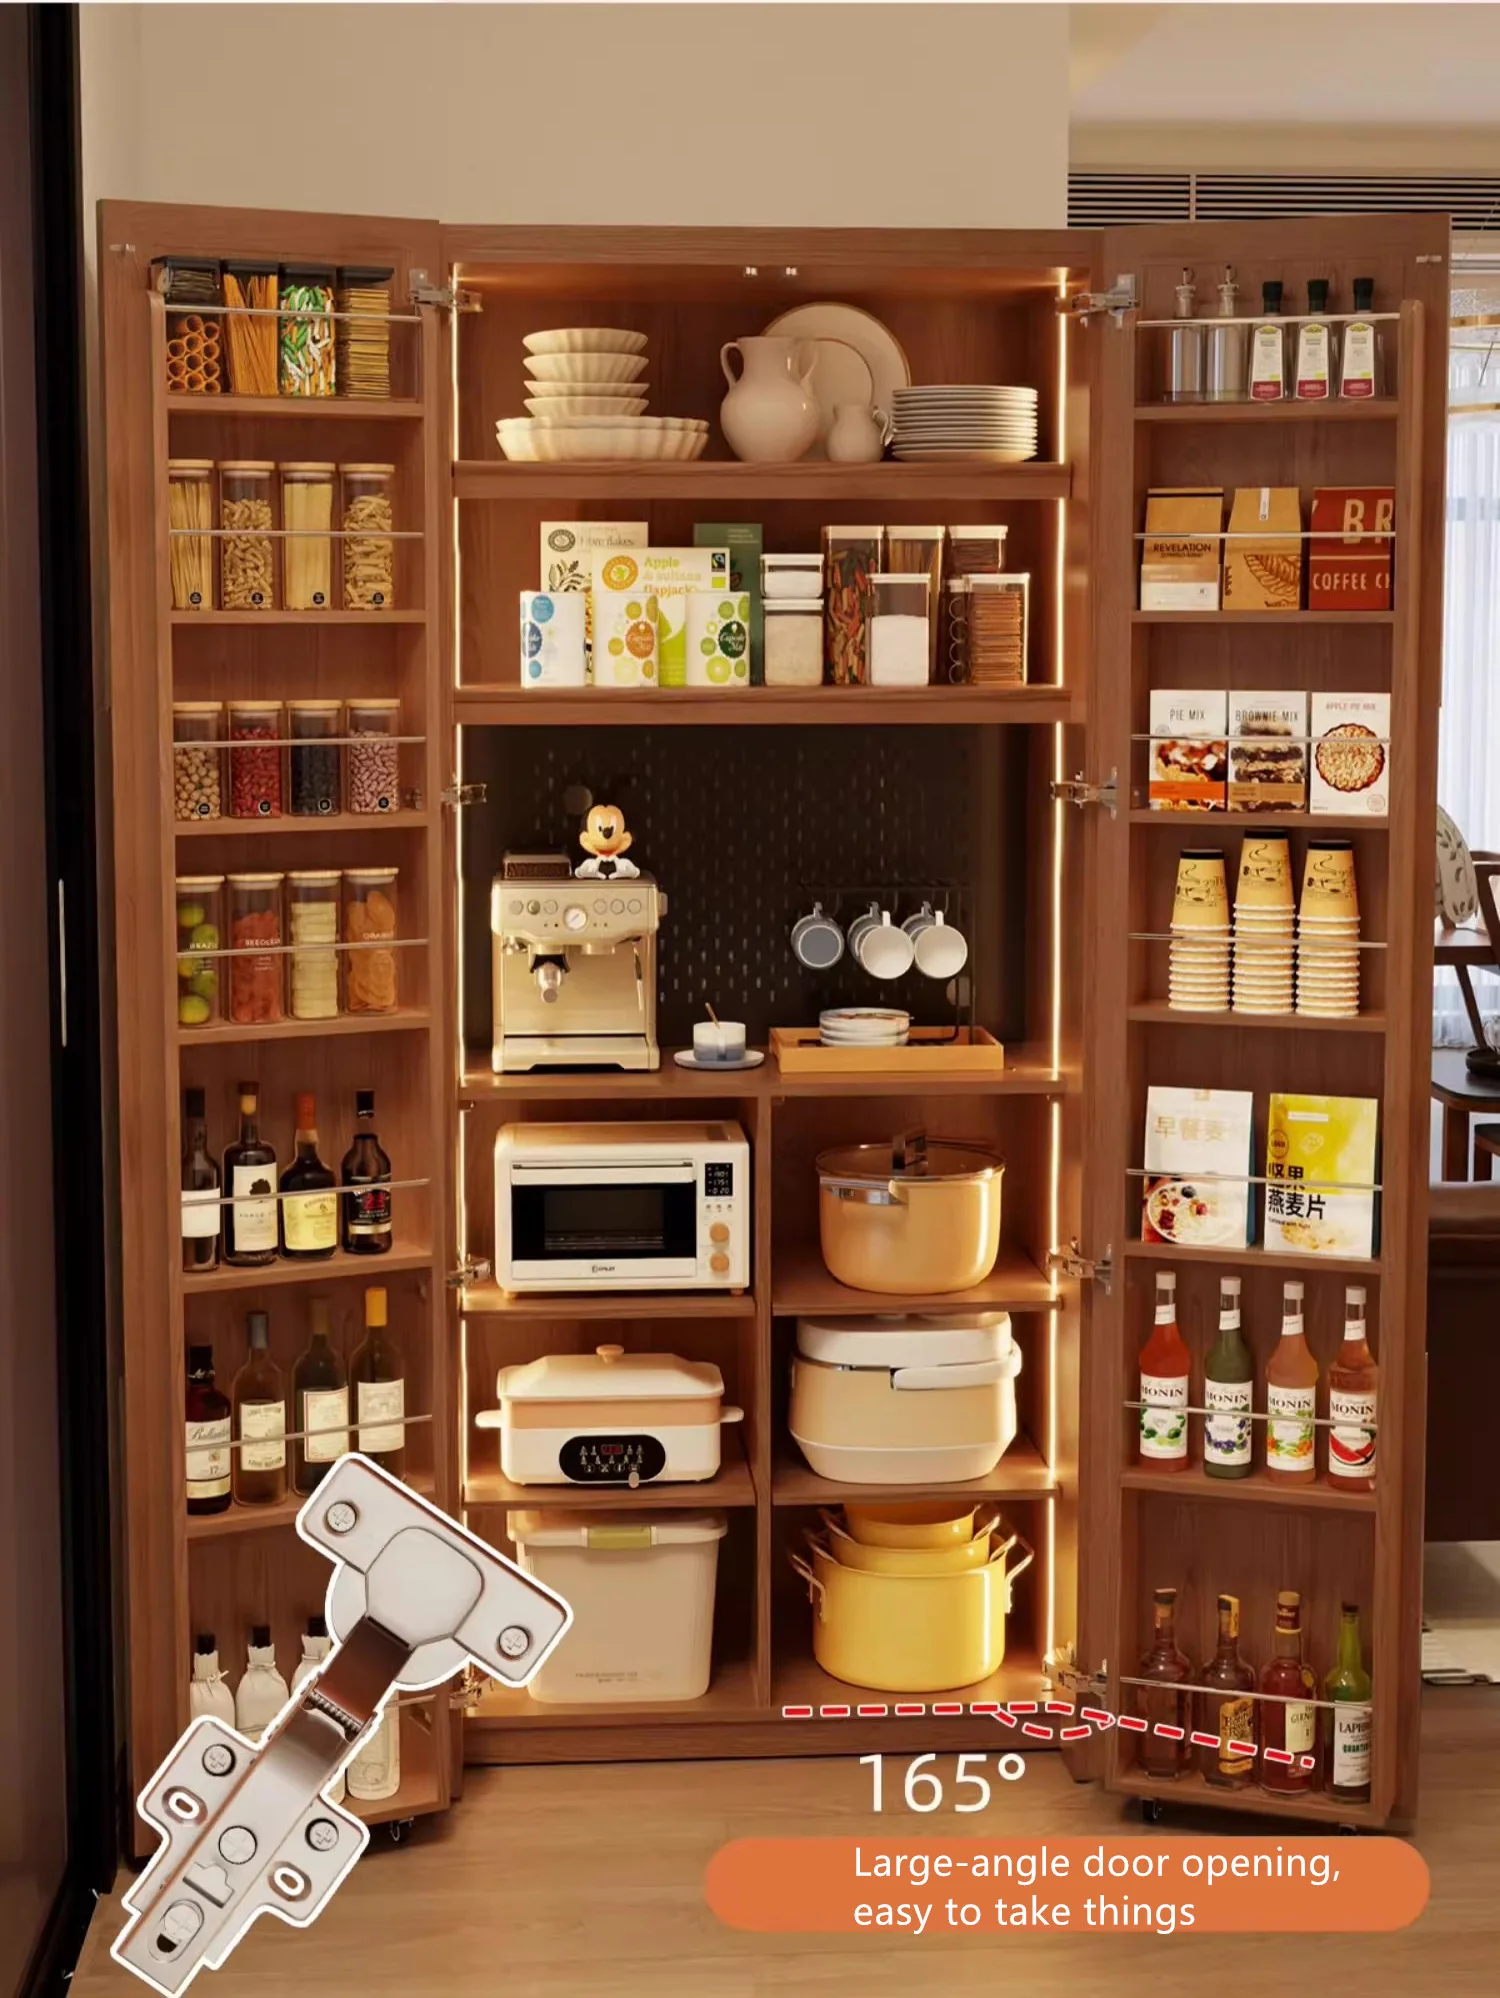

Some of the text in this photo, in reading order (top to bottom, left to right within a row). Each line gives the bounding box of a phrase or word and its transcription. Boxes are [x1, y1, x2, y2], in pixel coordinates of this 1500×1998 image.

[1153, 543, 1211, 552] REVELATION
[644, 556, 679, 570] Apple
[1312, 572, 1366, 590] COFFEE
[1169, 709, 1206, 721] PIE MIX
[1235, 710, 1299, 722] BROWNIE MIX
[1267, 1188, 1326, 1221] 燕麦片
[1142, 1386, 1184, 1398] MONIN
[1207, 1391, 1248, 1403] MONIN
[1269, 1396, 1312, 1409] MONIN
[1332, 1401, 1374, 1415] MONIN
